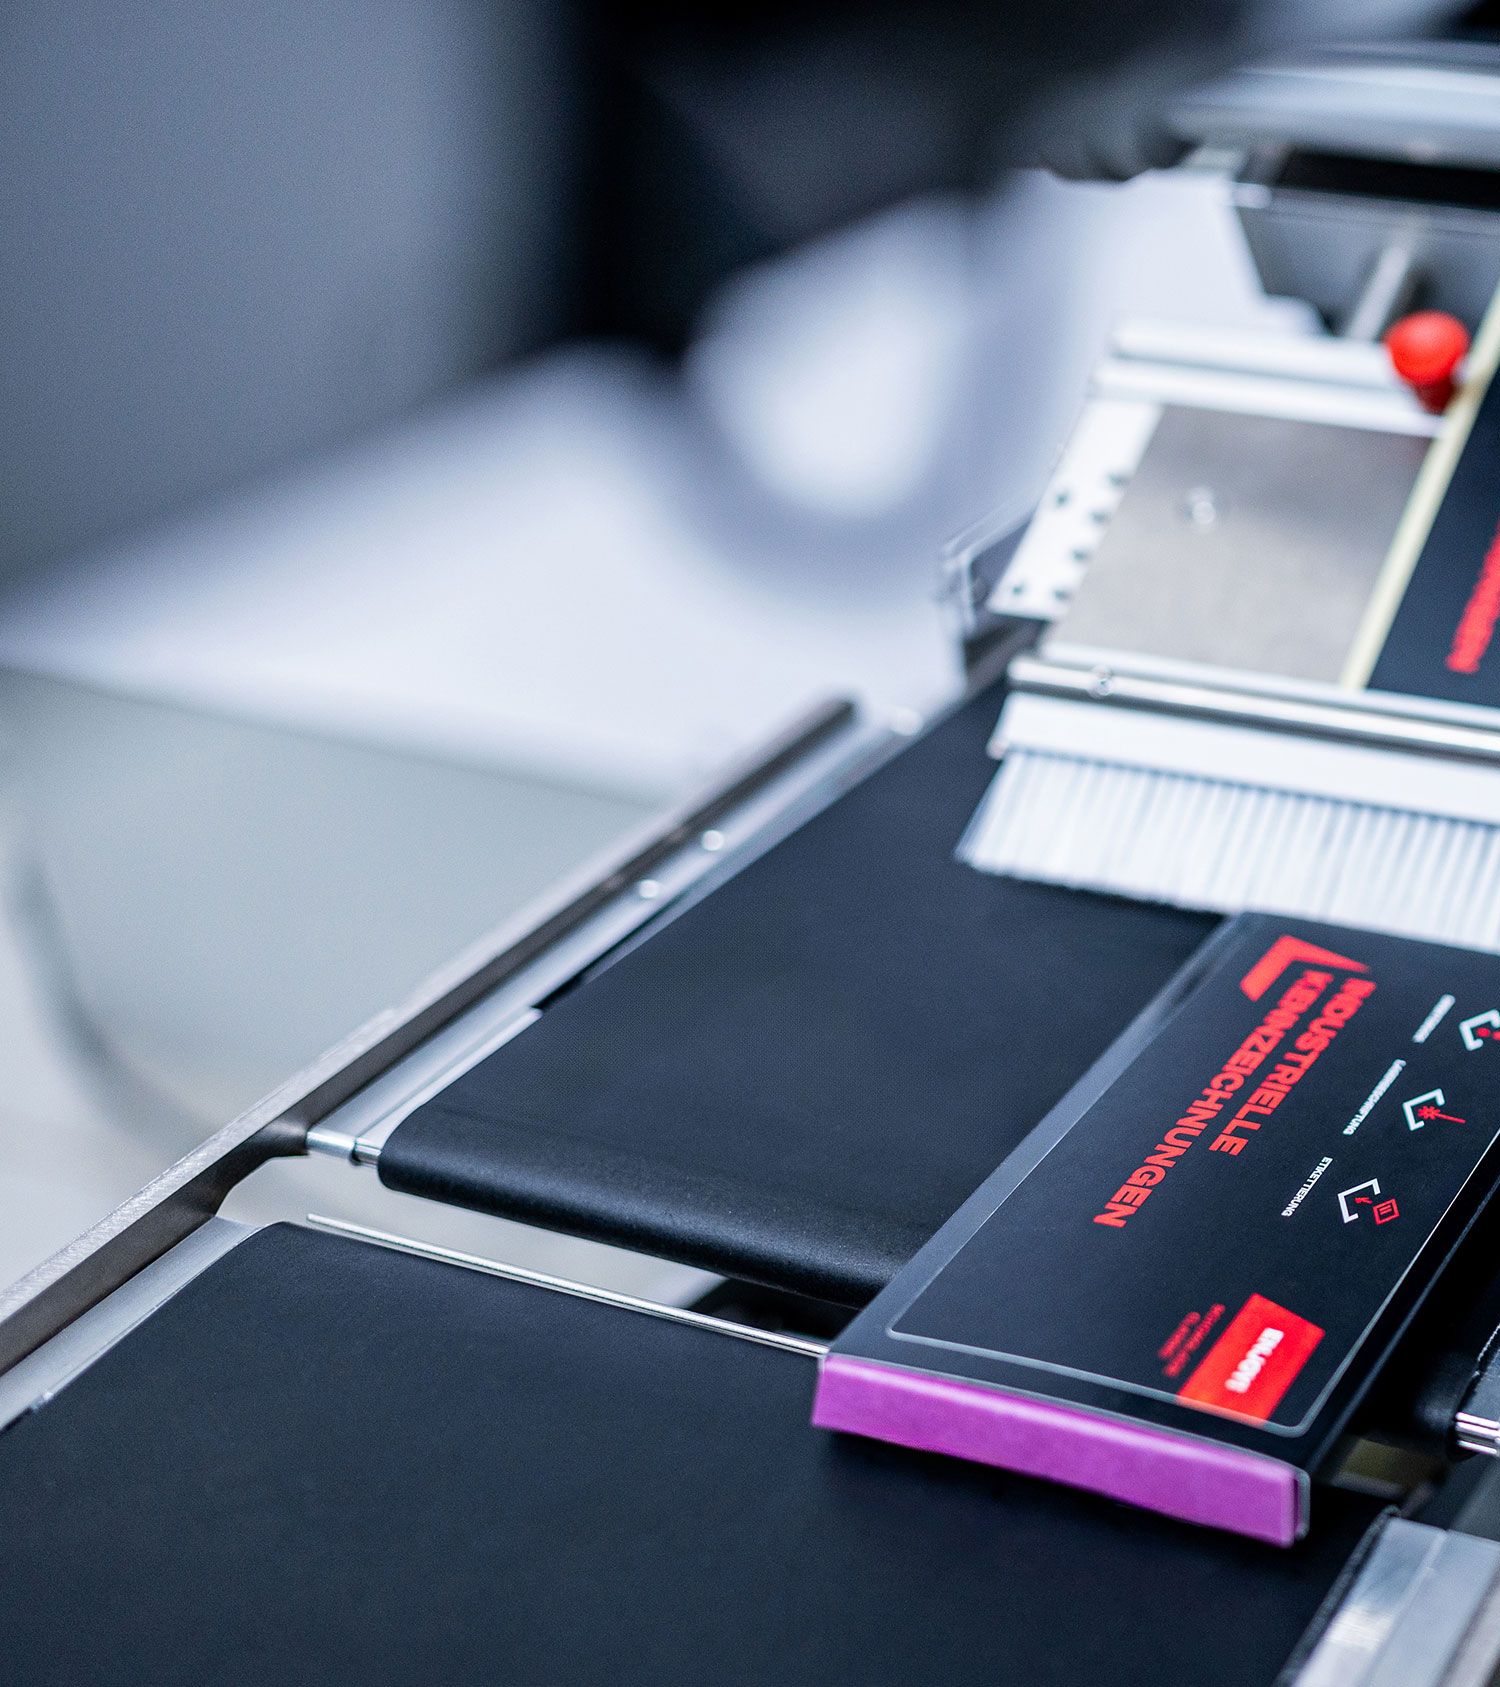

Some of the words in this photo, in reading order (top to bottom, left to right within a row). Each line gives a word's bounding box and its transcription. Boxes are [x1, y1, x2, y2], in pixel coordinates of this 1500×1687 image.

[1092, 969, 1335, 1228] KENNZEICHNUNGEN
[1208, 976, 1377, 1156] INDUSTRIELLE
[1281, 1156, 1333, 1217] ETIKETTIERUNG
